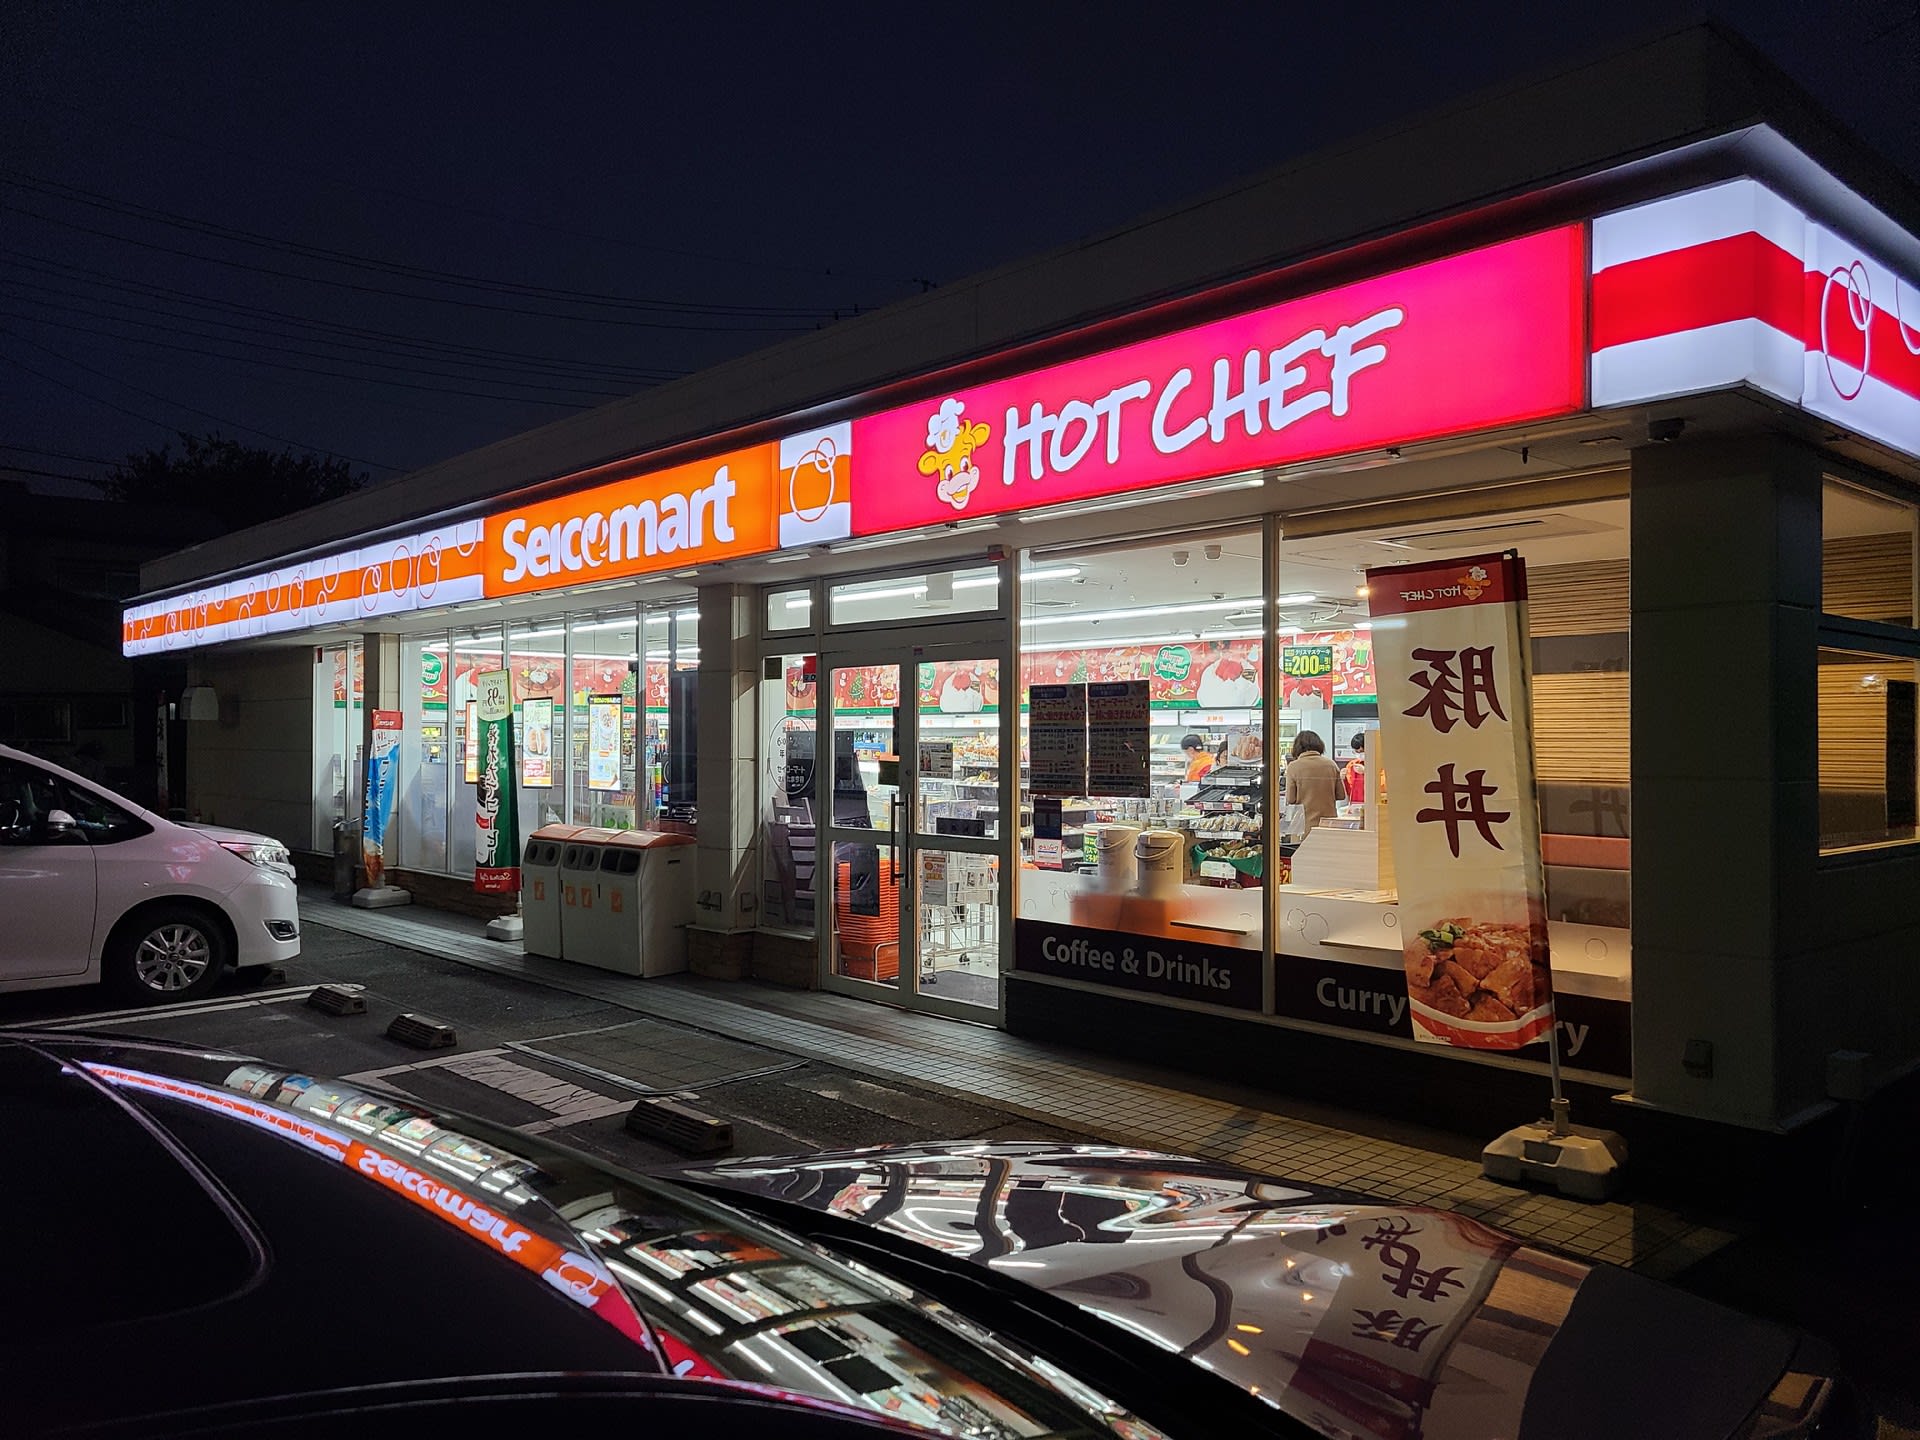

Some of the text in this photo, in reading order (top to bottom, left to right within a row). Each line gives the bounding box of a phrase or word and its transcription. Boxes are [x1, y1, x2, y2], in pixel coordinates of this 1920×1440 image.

[1002, 307, 1404, 486] HOT CHEF
[502, 465, 736, 583] Seicomart
[1041, 935, 1231, 991] Coffee & Drinks
[1315, 977, 1406, 1025] Curry
